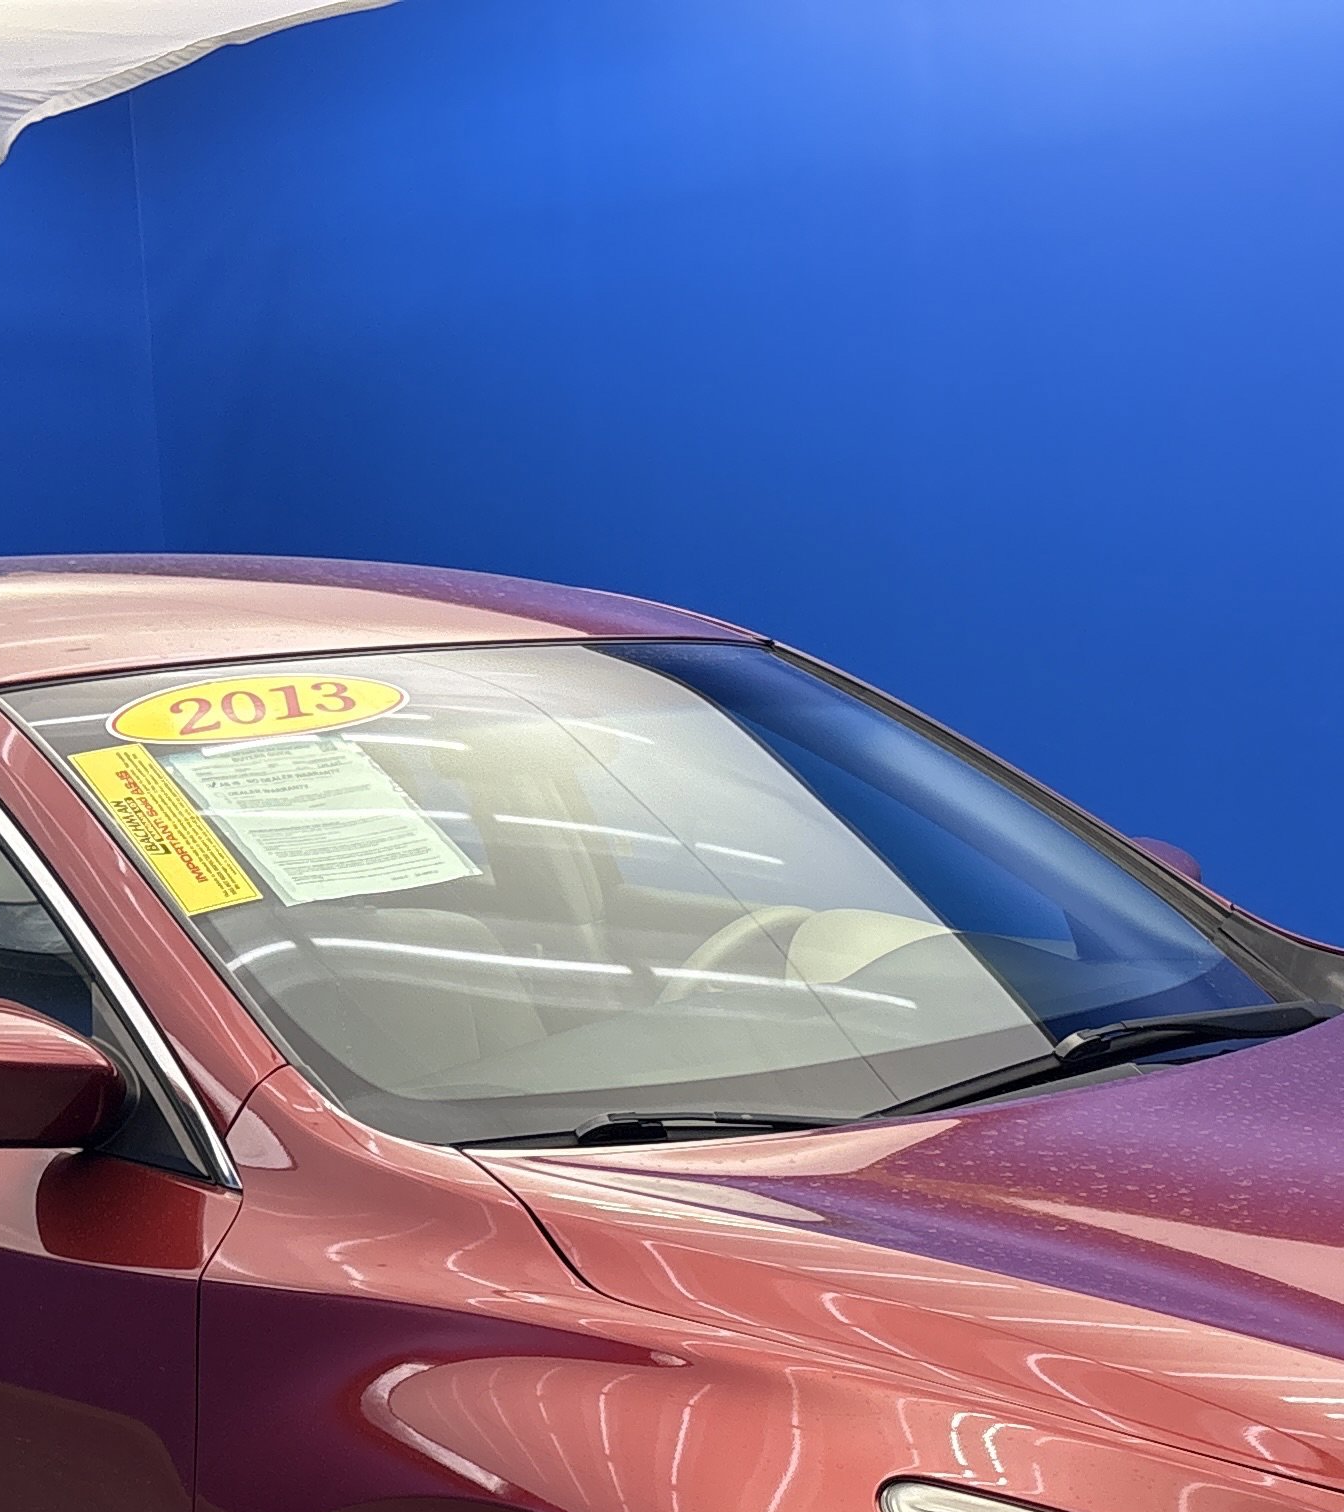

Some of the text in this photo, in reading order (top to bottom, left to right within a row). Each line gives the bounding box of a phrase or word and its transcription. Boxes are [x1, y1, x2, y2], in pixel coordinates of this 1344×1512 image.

[170, 681, 358, 737] 2013
[110, 800, 160, 853] BACHMAN
[138, 796, 159, 818] Sold
